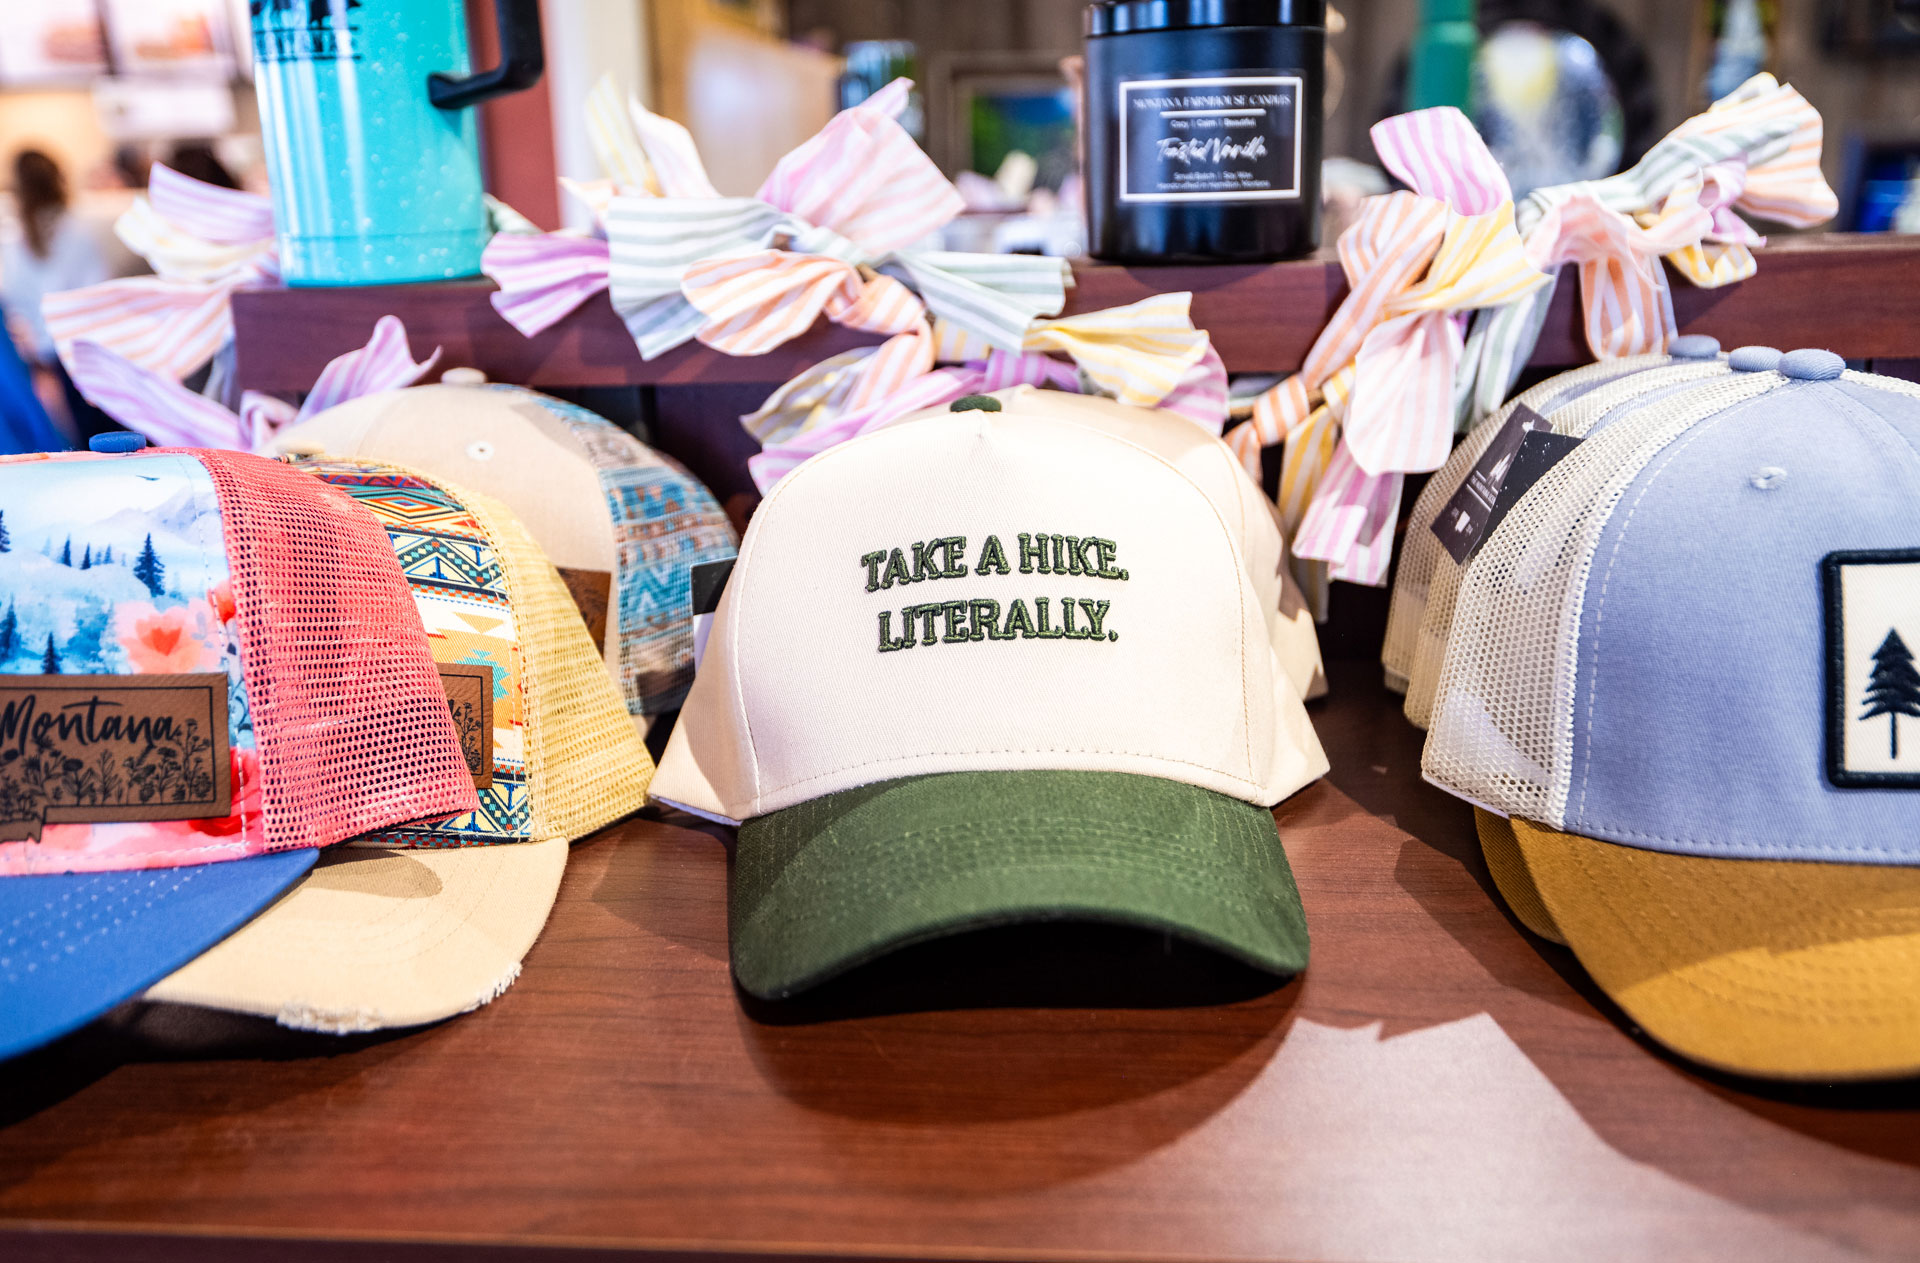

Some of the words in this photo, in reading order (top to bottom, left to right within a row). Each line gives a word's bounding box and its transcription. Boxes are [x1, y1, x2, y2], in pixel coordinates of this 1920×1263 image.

[860, 535, 968, 592] TAKE
[974, 534, 1011, 576] A
[1017, 532, 1129, 581] HIKE.
[877, 596, 1119, 653] LITERALLY.
[0, 694, 177, 755] Montana
